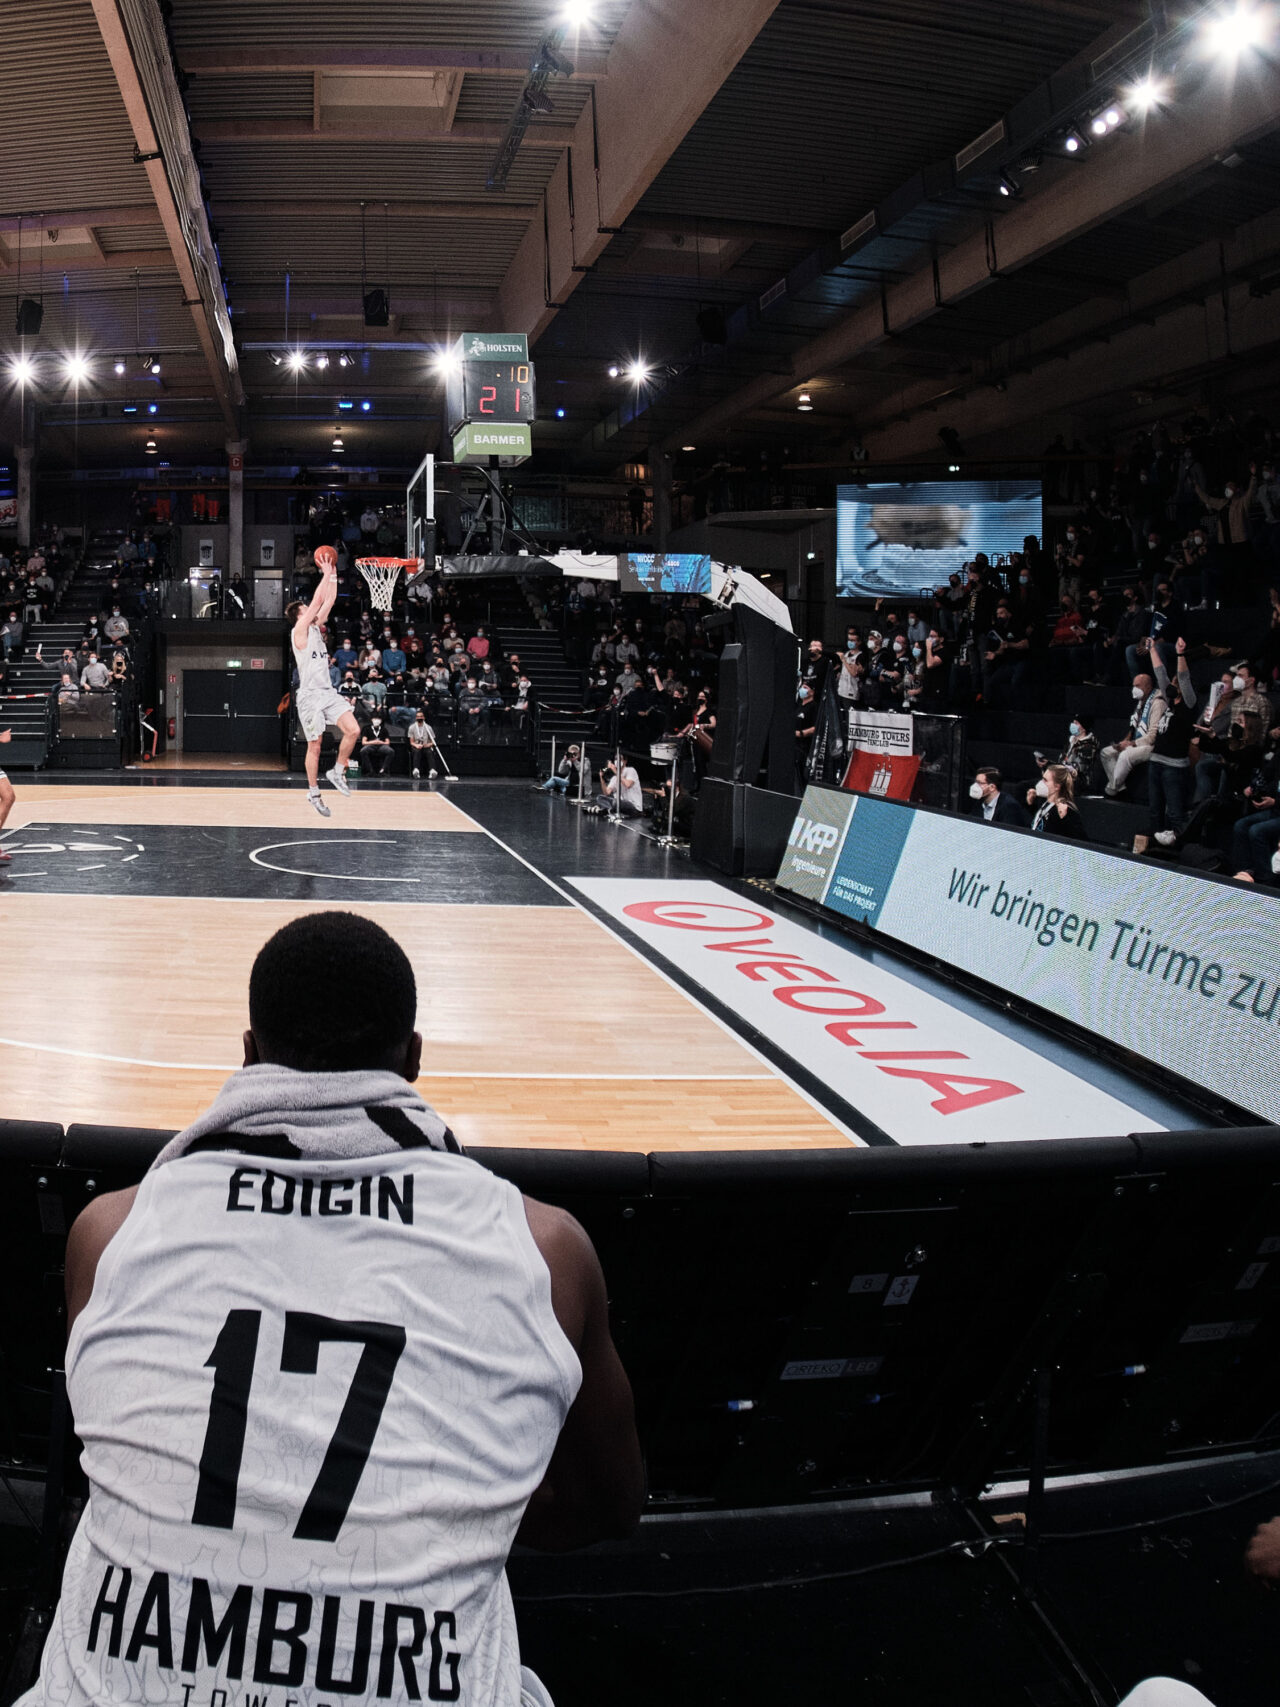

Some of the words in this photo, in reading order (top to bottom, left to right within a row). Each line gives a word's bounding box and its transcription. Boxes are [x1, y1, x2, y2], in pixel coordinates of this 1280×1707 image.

[486, 344, 523, 353] HOLSTEN
[473, 434, 525, 445] BARMER
[848, 727, 880, 740] HAMBURG
[881, 729, 910, 743] TOWERS
[836, 875, 875, 897] LEIDENSCHAFT
[842, 890, 855, 903] DAS
[853, 895, 877, 911] PROJEKT
[947, 867, 990, 910] Wir
[989, 879, 1101, 952] bringen
[1108, 918, 1224, 999] Türme
[702, 937, 1026, 1117] VEOLIA
[224, 1166, 415, 1226] EDIGIN
[844, 1360, 878, 1373] LED
[190, 1308, 407, 1543] 17
[86, 1564, 462, 1704] HAMBURG
